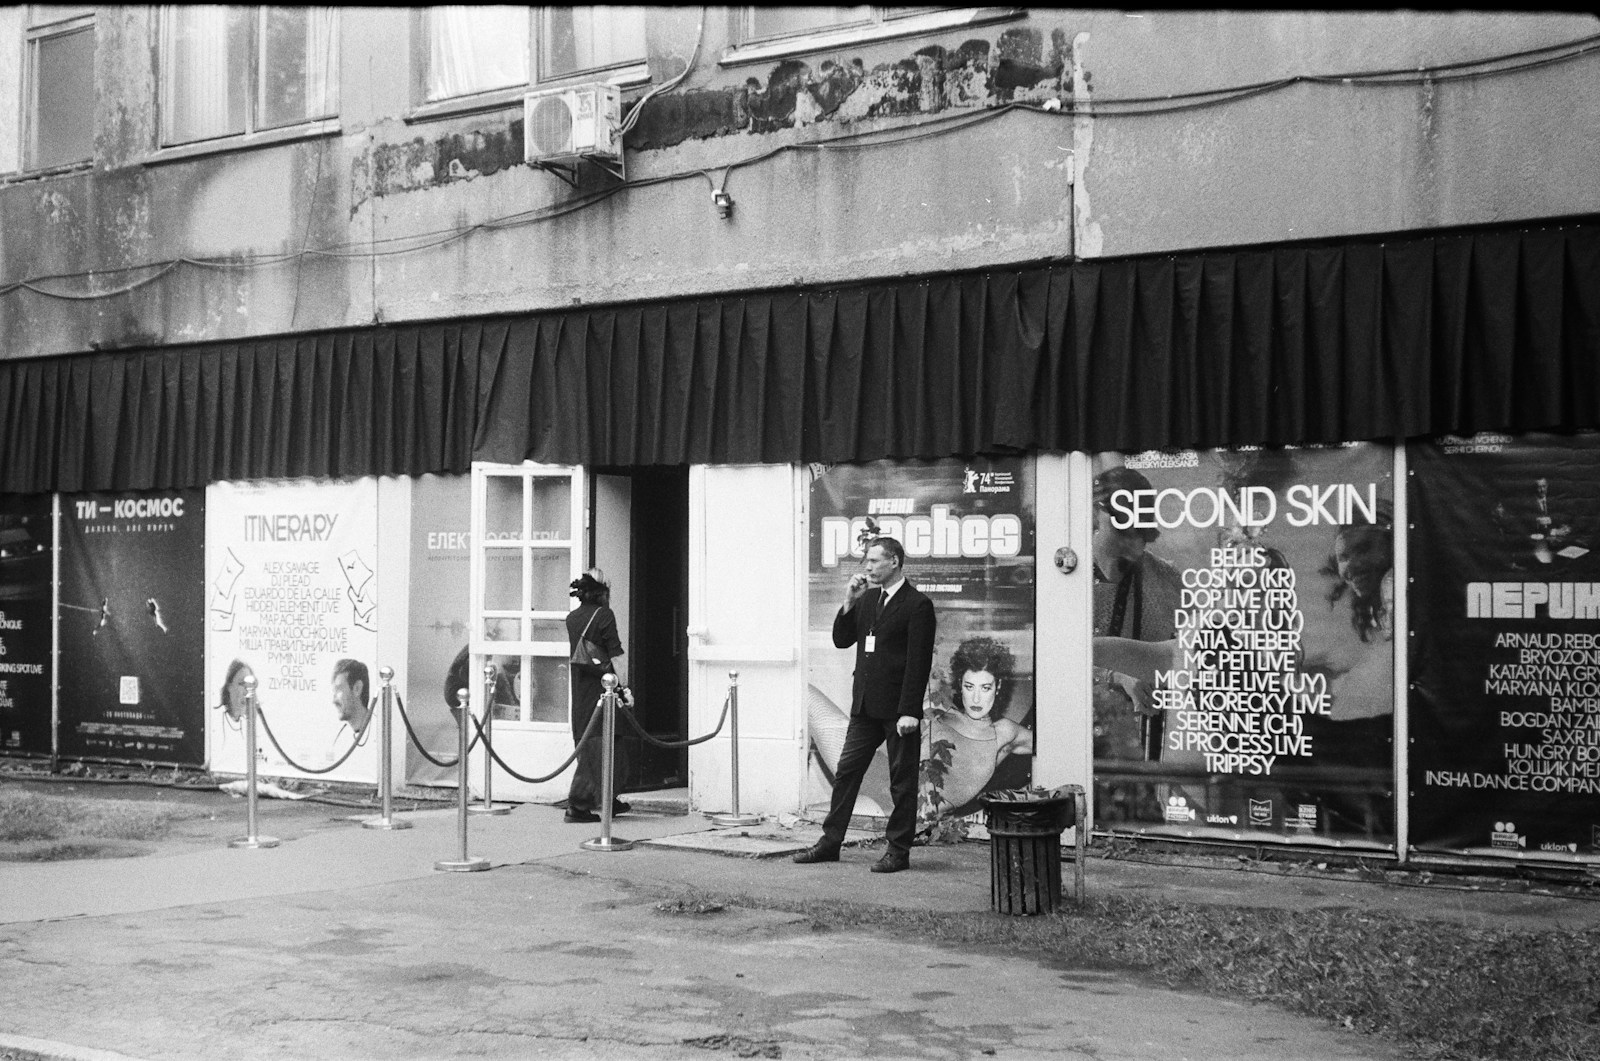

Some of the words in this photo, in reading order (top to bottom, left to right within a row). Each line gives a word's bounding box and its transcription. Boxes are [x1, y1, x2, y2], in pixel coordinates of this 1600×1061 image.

[76, 501, 96, 519] ТИ
[114, 498, 184, 518] КОСМОС
[1110, 486, 1277, 530] SECOND
[1285, 483, 1377, 527] SKIN
[244, 513, 339, 541] ITINERARY
[264, 562, 284, 573] ALEX
[286, 562, 320, 574] SAVAGE
[271, 575, 281, 586] DJ
[283, 575, 311, 586] PLEAD
[1182, 568, 1257, 588] COSMO
[1260, 568, 1296, 591] (KR)
[244, 587, 286, 599] EDUARDO
[287, 588, 299, 599] DE
[300, 588, 311, 599] LA
[314, 587, 341, 600] CALLE
[1181, 589, 1221, 608] DOP
[1225, 589, 1261, 608] LIVE
[1265, 589, 1297, 612] (FR)
[246, 600, 278, 612] HIDDEN
[279, 600, 320, 612] ELEMENT
[321, 601, 340, 613] LIVE
[260, 614, 304, 626] MAPACHE
[307, 614, 324, 626] LIVE
[1175, 609, 1196, 628] DJ
[1200, 609, 1258, 629] KOOLT
[1262, 610, 1304, 633] (UY)
[240, 626, 280, 638] MARYANA
[284, 627, 328, 639] KLOCHKO
[330, 628, 347, 640] LIVE
[1179, 630, 1228, 649] KATIA
[1231, 631, 1302, 651] STIEBER
[1495, 633, 1562, 648] ARNAUD
[330, 641, 347, 653] LIVE
[268, 652, 297, 664] PYMIN
[299, 653, 316, 665] LIVE
[1257, 652, 1295, 672] LIVE
[281, 665, 303, 678] OLES
[1490, 664, 1571, 680] KATARYNA
[299, 679, 316, 691] LIVE
[1155, 670, 1240, 691] MICHELLE
[1244, 672, 1280, 692] LIVE
[1284, 673, 1326, 696] (UY)
[1485, 680, 1564, 696] MARYANA
[1152, 690, 1197, 710] SEBA
[1200, 692, 1291, 713] KORECKY
[1292, 694, 1331, 715] LIVE
[1551, 698, 1600, 713] BAMB
[1177, 711, 1260, 733] SERENNE
[1264, 713, 1303, 736] (CH)
[1501, 711, 1571, 728] BOGDAN
[1574, 714, 1600, 729] ZAI
[1169, 731, 1183, 750] SI
[1187, 732, 1273, 754] PROCESS
[1275, 736, 1313, 756] LIVE
[1542, 729, 1585, 745] SAXR
[1505, 743, 1574, 760] HUNGRY
[1204, 753, 1276, 775] TRIPPSY
[1508, 759, 1569, 776] КОШИК
[1426, 771, 1471, 787] INSHA
[1474, 773, 1529, 790] DANCE
[1206, 814, 1230, 824] uklon
[1540, 842, 1567, 852] uklon
